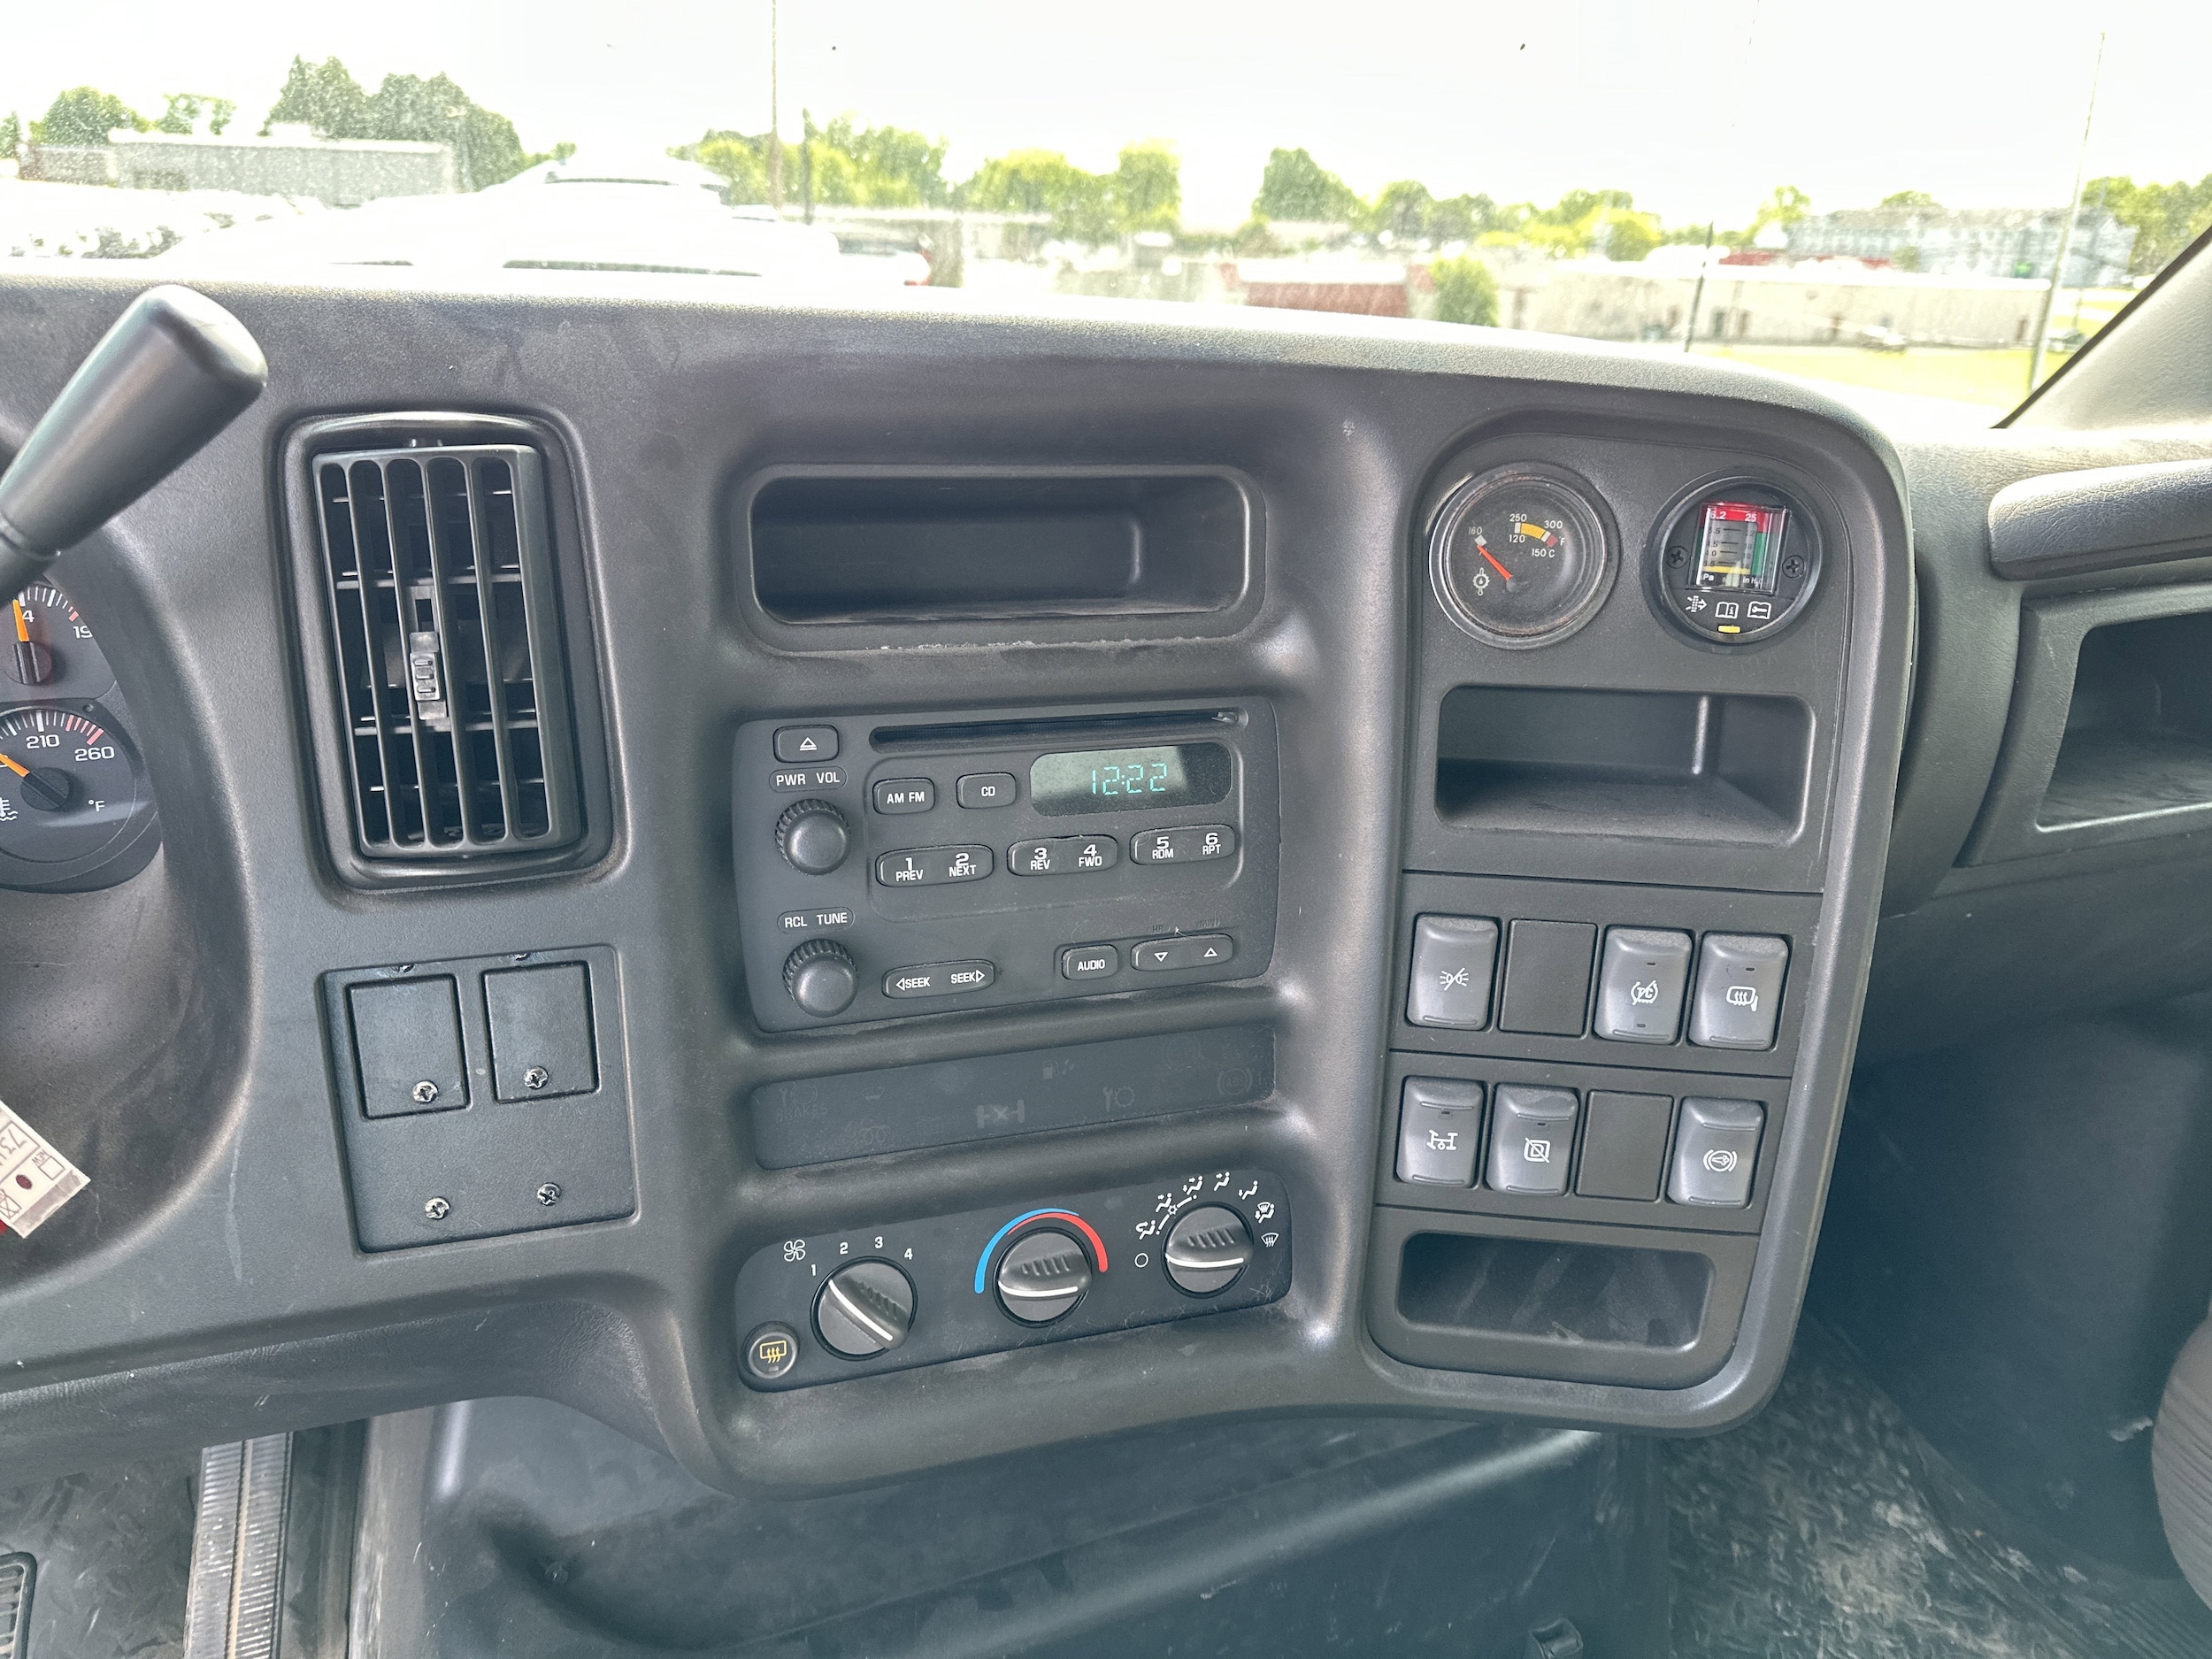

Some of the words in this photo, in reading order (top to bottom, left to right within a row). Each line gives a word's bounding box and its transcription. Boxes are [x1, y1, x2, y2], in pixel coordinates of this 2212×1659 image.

[1509, 513, 1527, 523] 250
[1709, 511, 1727, 520] 6.2
[1744, 513, 1757, 522] 25
[1469, 526, 1483, 535] 160
[1544, 520, 1563, 529] 300
[1509, 534, 1525, 543] 120
[1532, 549, 1547, 557] 150
[26, 733, 60, 749] 210
[74, 746, 115, 762] 260
[776, 773, 806, 786] PWR
[816, 772, 841, 784] VOL
[1092, 763, 1167, 795] 12:22
[887, 793, 904, 804] AM
[909, 791, 925, 803] FM
[980, 786, 995, 797] CD
[1156, 836, 1170, 849] 5
[1205, 833, 1218, 845] 6
[1033, 847, 1048, 860] 3
[1083, 844, 1097, 856] 4
[1152, 849, 1174, 860] RDM
[1202, 843, 1221, 856] RPT
[904, 857, 913, 871] 1
[955, 853, 969, 866] 2
[1030, 859, 1050, 871] REV
[1078, 856, 1102, 868] FWD
[895, 869, 924, 881] PREV
[949, 864, 977, 878] NEXT
[784, 916, 808, 928] RCL
[817, 912, 848, 926] TUNE
[1077, 958, 1106, 972] AUDIO
[904, 977, 931, 989] SEEK
[950, 972, 975, 985] SEEK
[840, 1241, 849, 1255] 2
[874, 1236, 883, 1249] 3
[903, 1248, 913, 1260] 4
[810, 1263, 818, 1277] 1
